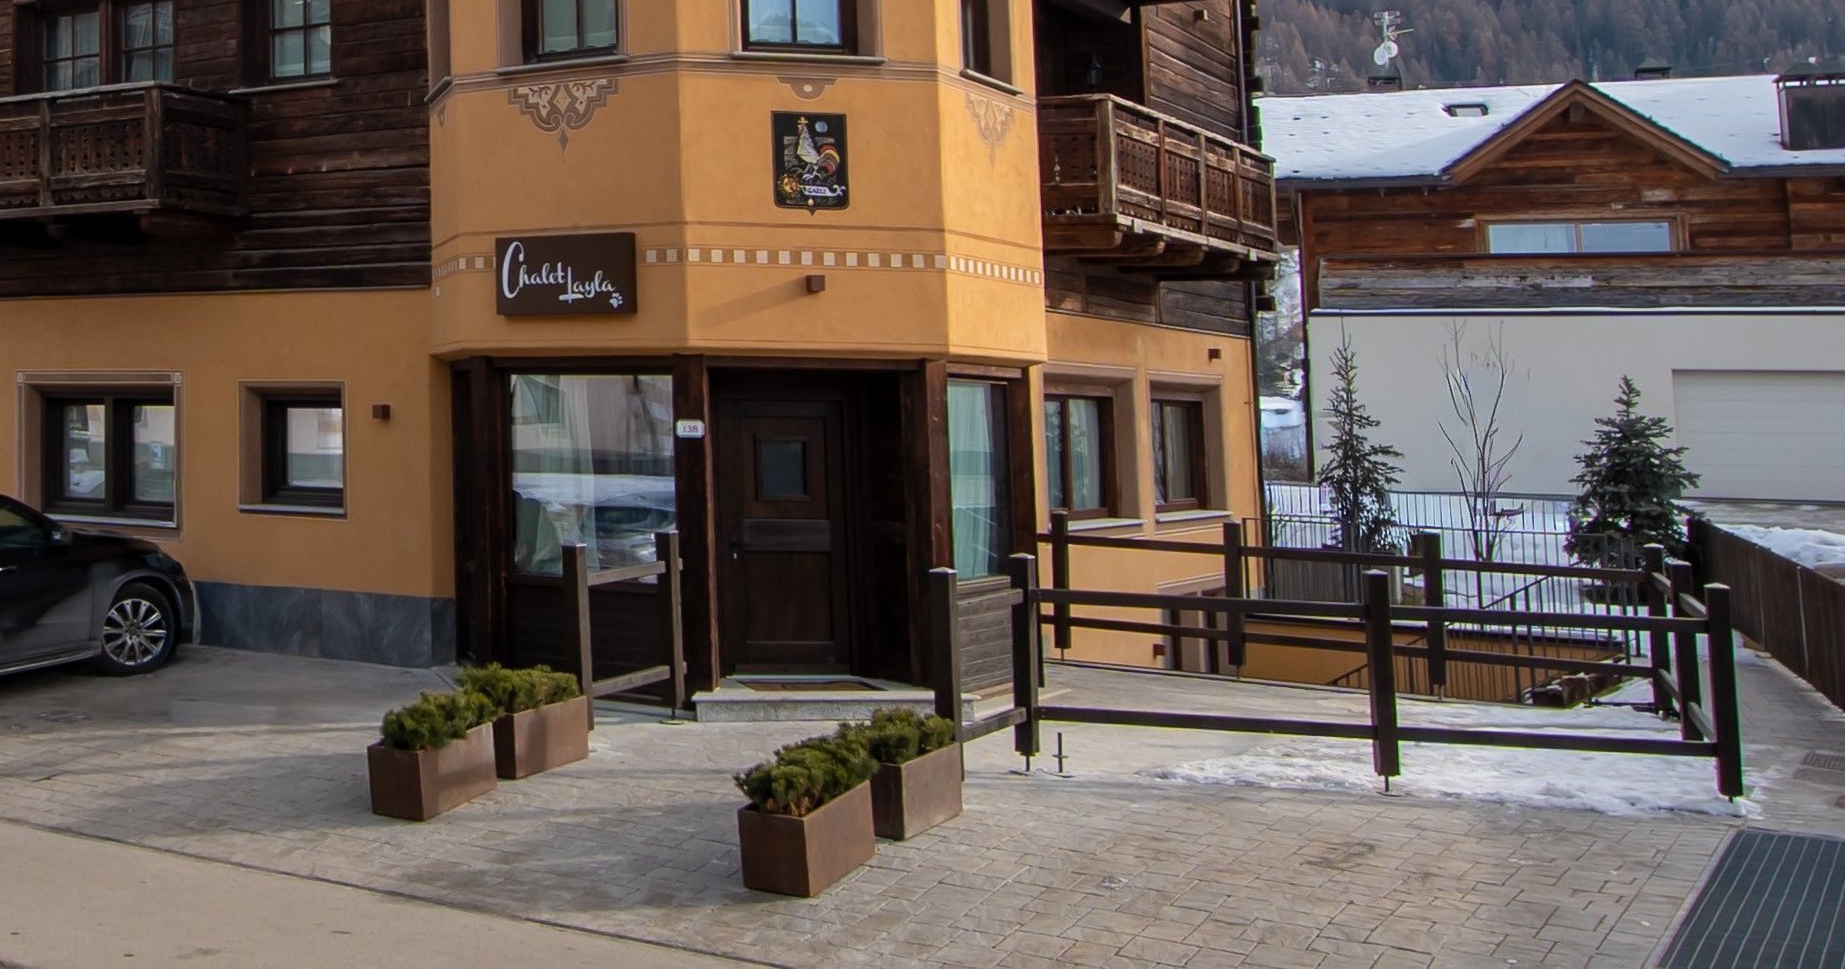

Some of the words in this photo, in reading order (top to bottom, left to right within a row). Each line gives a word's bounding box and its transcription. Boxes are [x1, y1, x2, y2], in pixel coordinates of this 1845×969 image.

[502, 241, 566, 299] Chalet
[558, 266, 616, 304] Layla
[682, 425, 699, 433] 138
